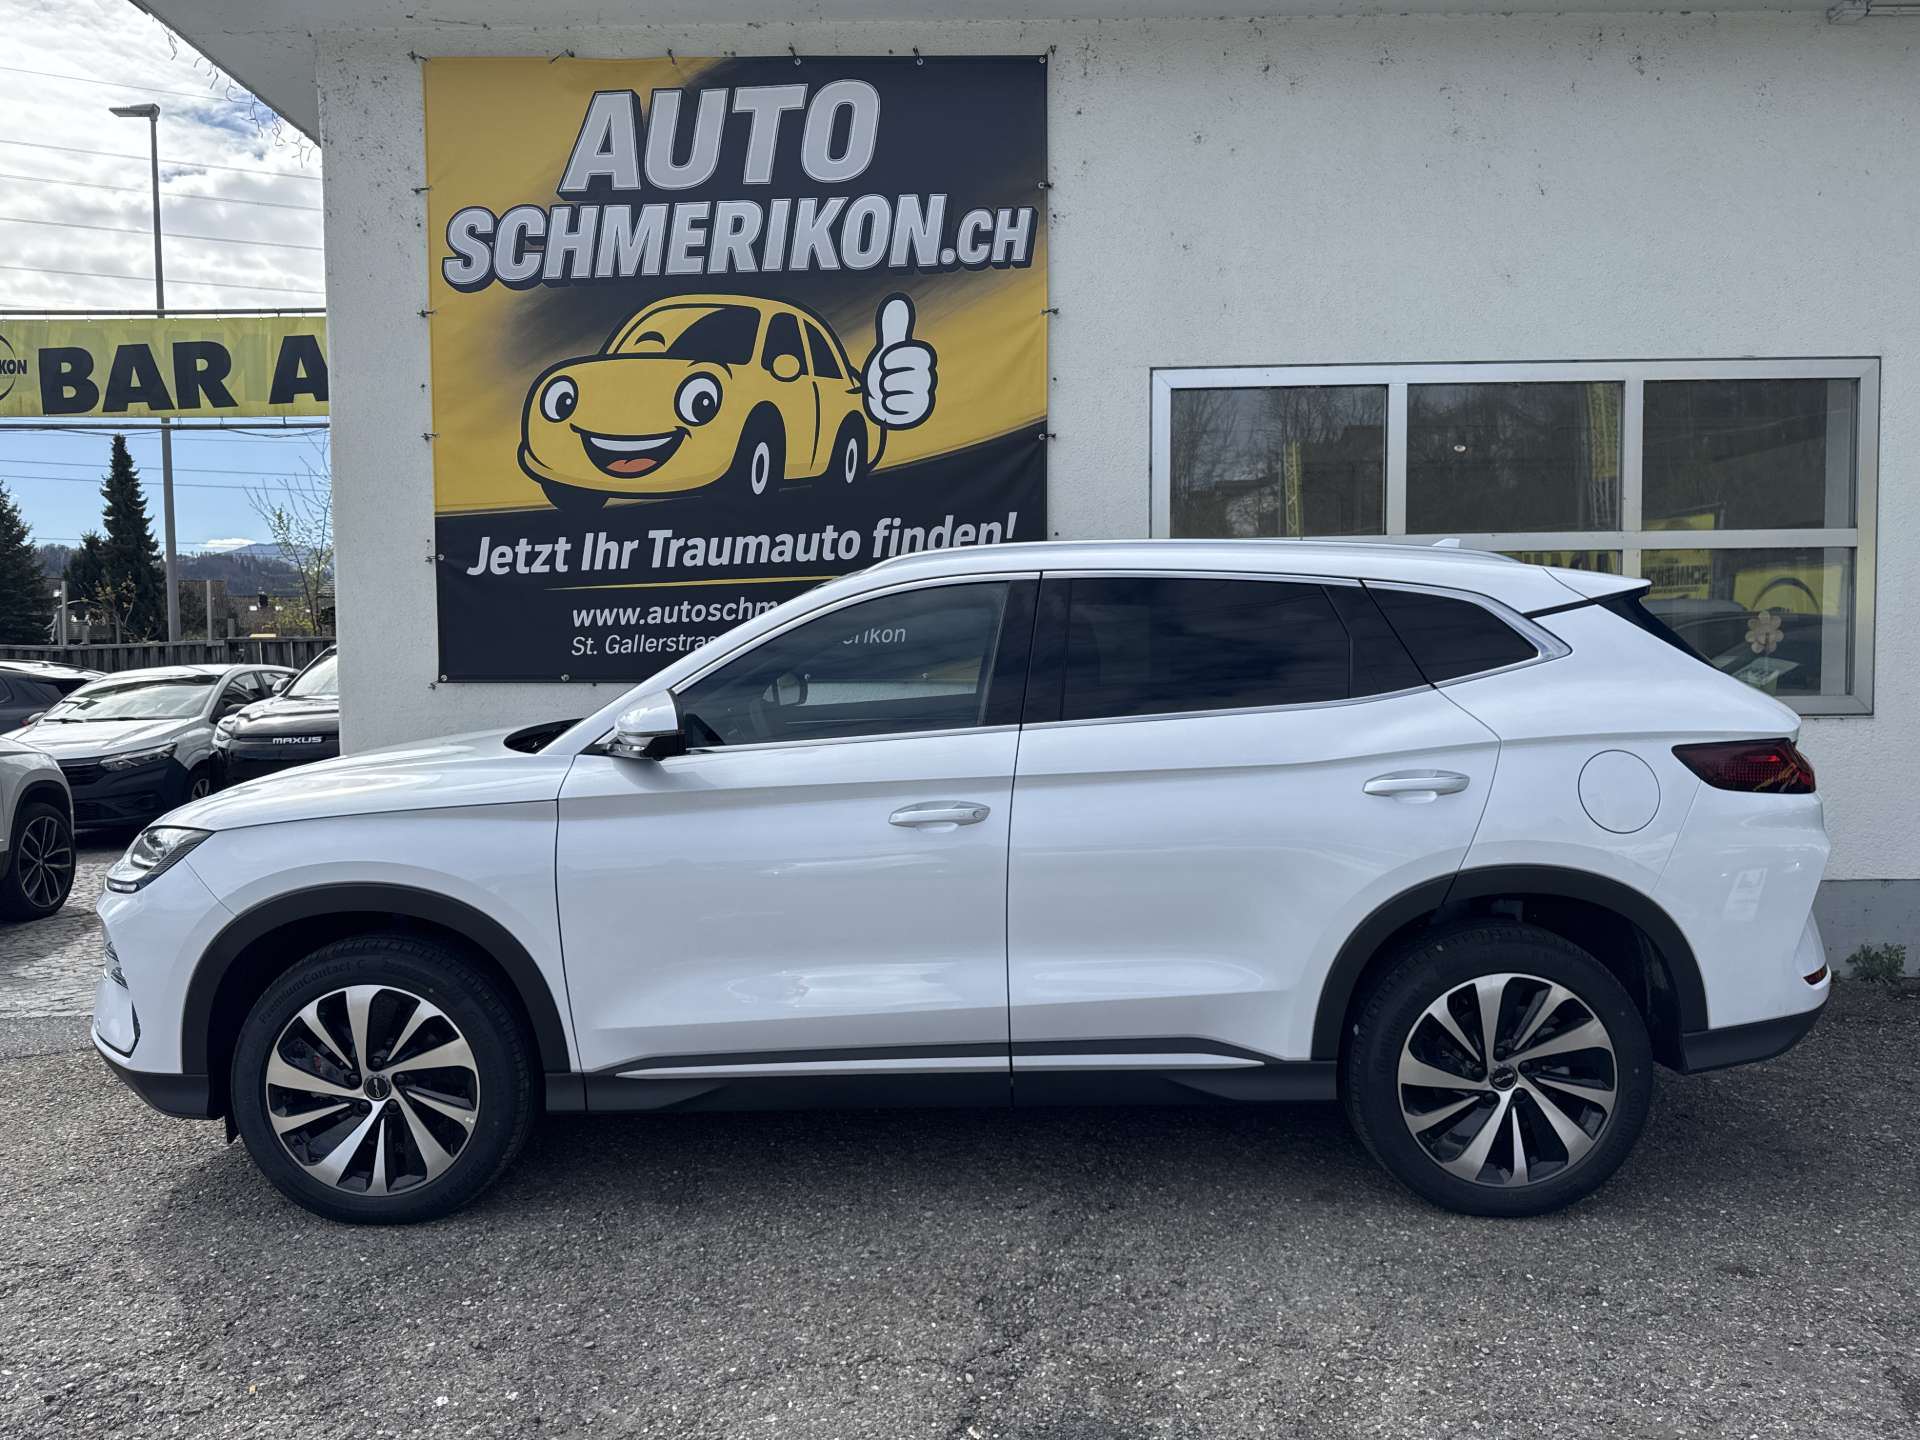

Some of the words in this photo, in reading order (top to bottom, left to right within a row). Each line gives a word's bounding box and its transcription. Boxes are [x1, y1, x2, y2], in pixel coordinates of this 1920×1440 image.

[558, 78, 882, 194] AUTO
[442, 193, 1036, 288] SCHMERIKON.CH
[38, 341, 239, 415] BAR
[467, 537, 571, 577] Jetzt
[581, 532, 637, 571] Ihr
[648, 524, 861, 569] Traumauto
[873, 511, 1018, 558] finden!
[571, 636, 598, 656] St.
[272, 736, 323, 744] MAXUS
